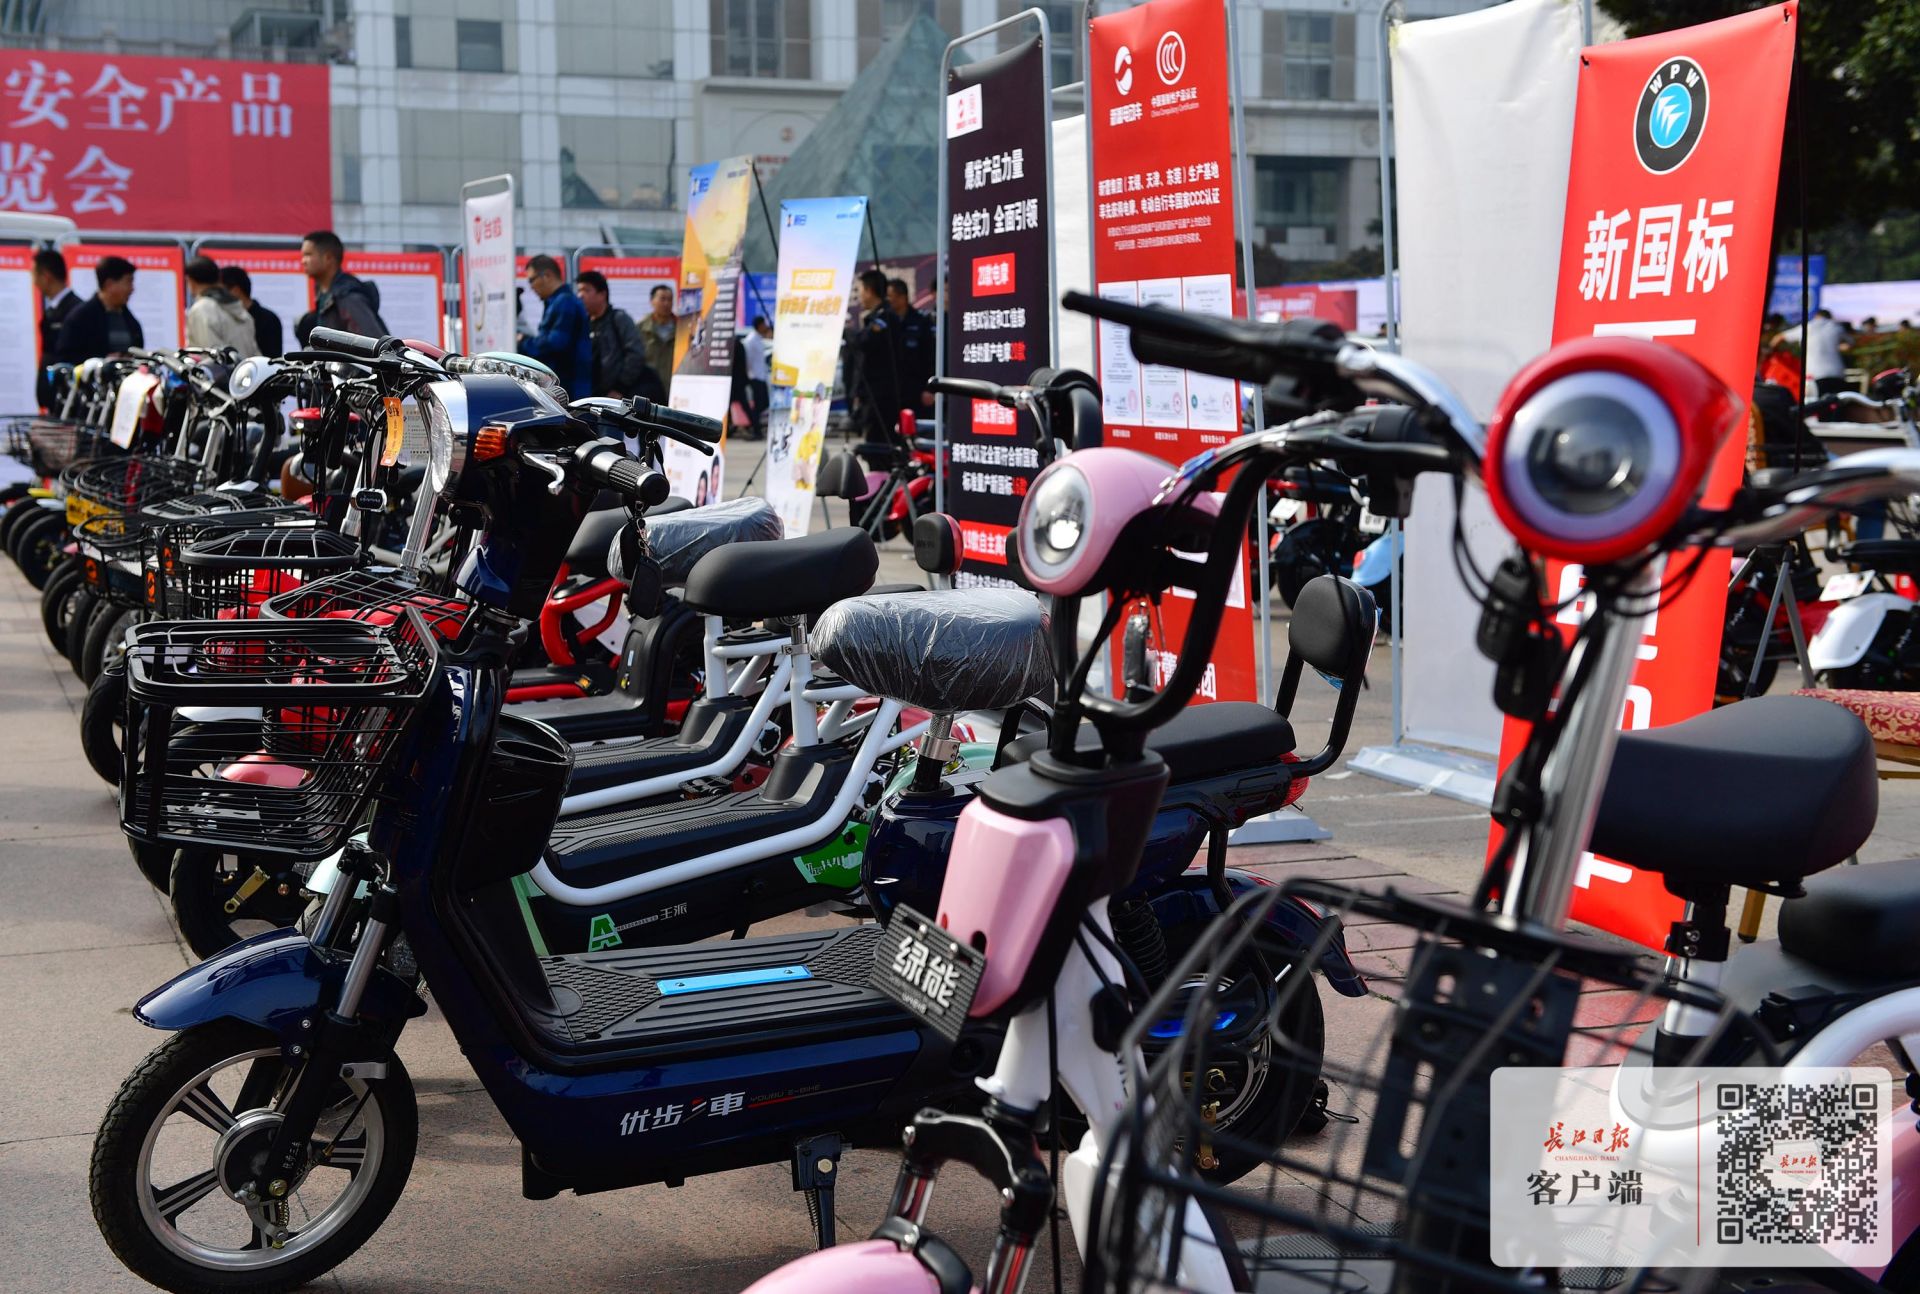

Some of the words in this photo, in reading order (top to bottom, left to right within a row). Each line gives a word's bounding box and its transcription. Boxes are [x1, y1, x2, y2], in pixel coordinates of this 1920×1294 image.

[5, 59, 292, 137] 安全产品
[1649, 64, 1700, 94] WPW
[0, 142, 133, 215] 览会
[964, 148, 1024, 190] 爆发产品力量
[952, 208, 990, 242] 综合实力
[993, 198, 1039, 235] 全面引领
[1578, 198, 1734, 302] 新国标
[660, 902, 687, 921] 王派
[892, 935, 960, 1009] 绿能
